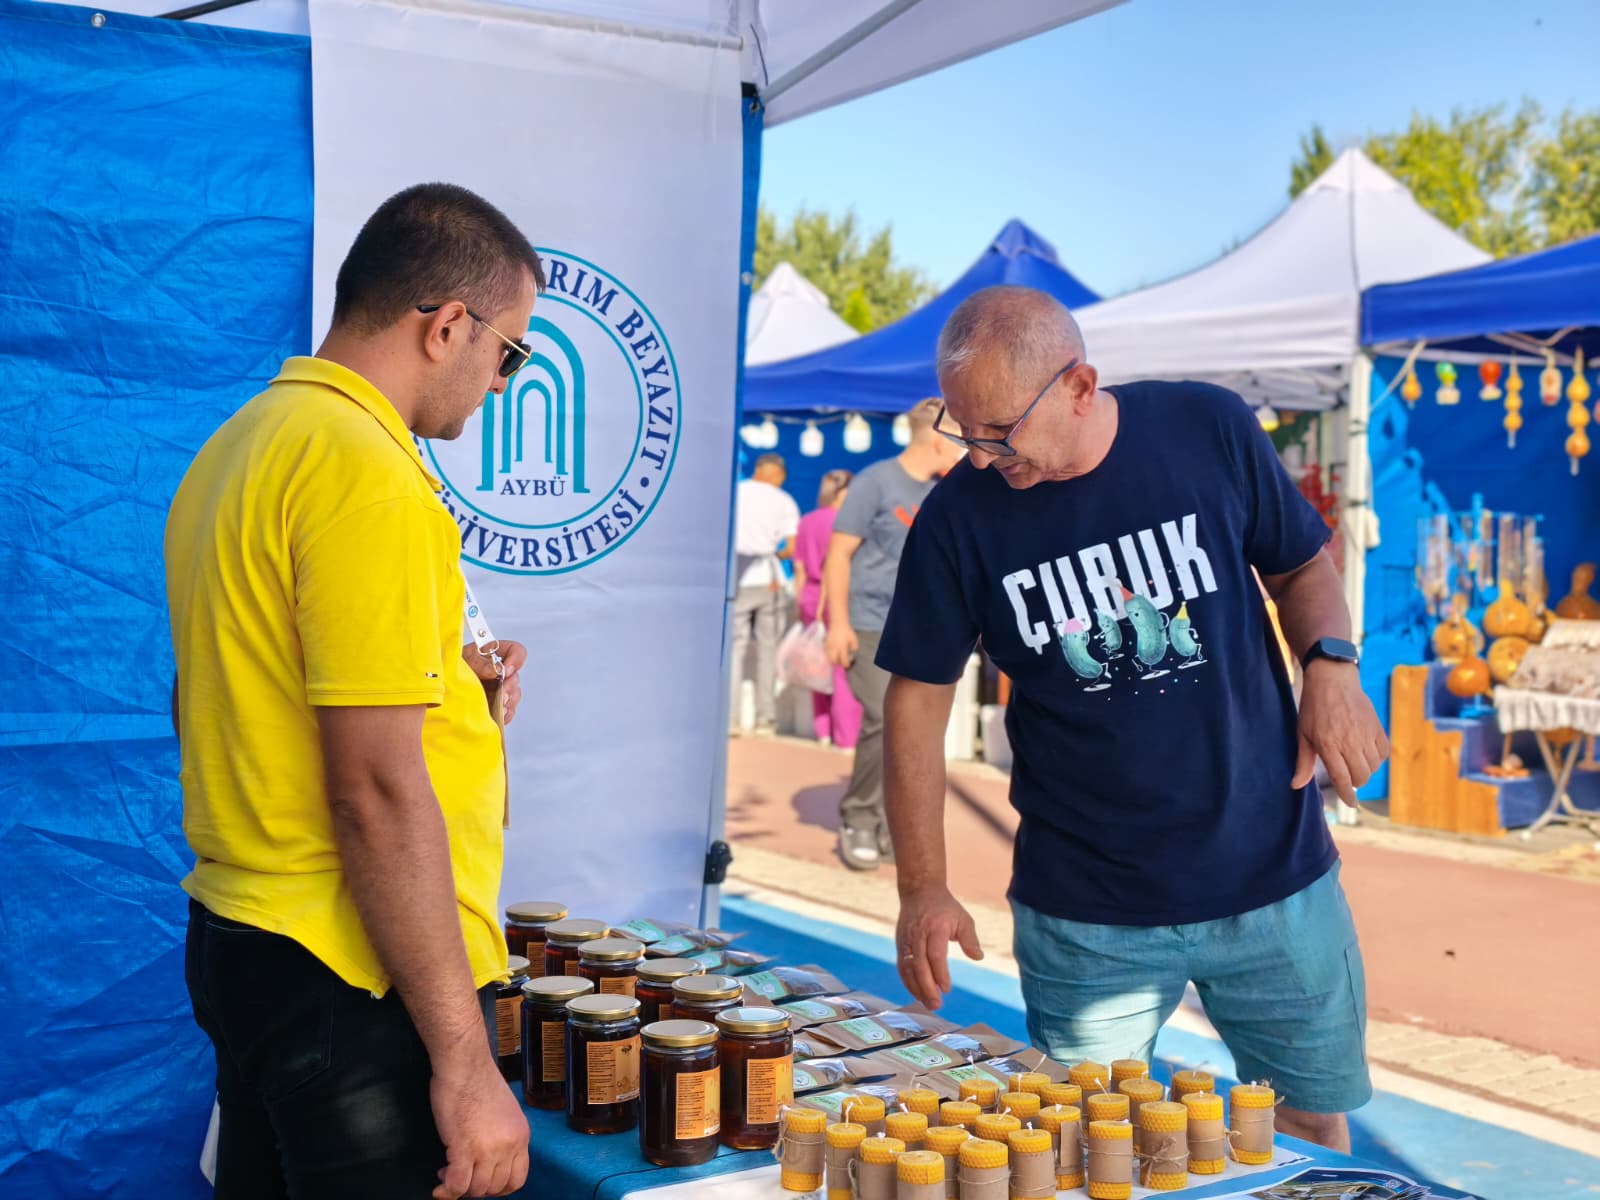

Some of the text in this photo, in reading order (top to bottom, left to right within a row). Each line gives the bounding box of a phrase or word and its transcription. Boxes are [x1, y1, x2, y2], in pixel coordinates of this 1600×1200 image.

[539, 258, 673, 470] RIM BEYAZIT
[500, 476, 565, 496] AYBÜ
[1002, 513, 1218, 655] ÇUBUK
